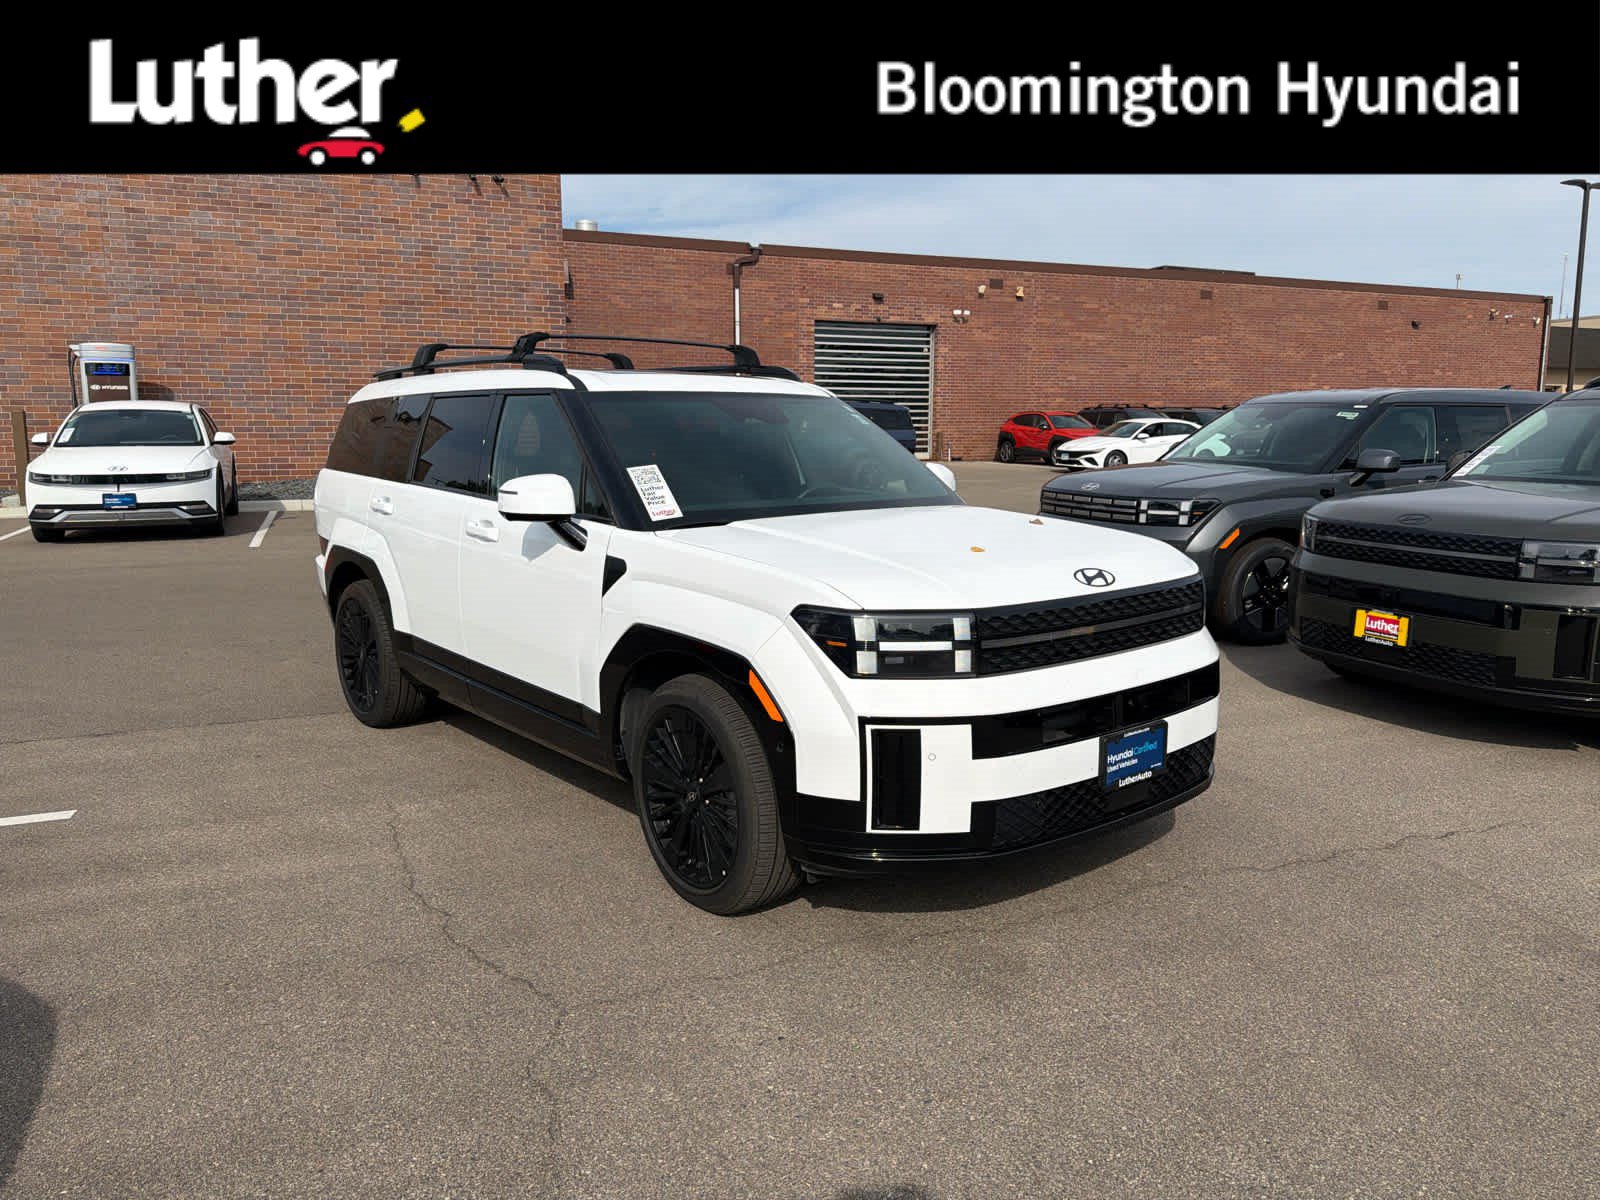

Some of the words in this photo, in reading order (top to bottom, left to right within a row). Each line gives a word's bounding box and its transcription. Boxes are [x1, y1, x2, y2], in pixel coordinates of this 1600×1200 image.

[1366, 616, 1399, 635] Luther
[1107, 748, 1133, 764] Hyundai
[1134, 741, 1157, 755] Certified
[1119, 771, 1152, 787] LutherAuto
